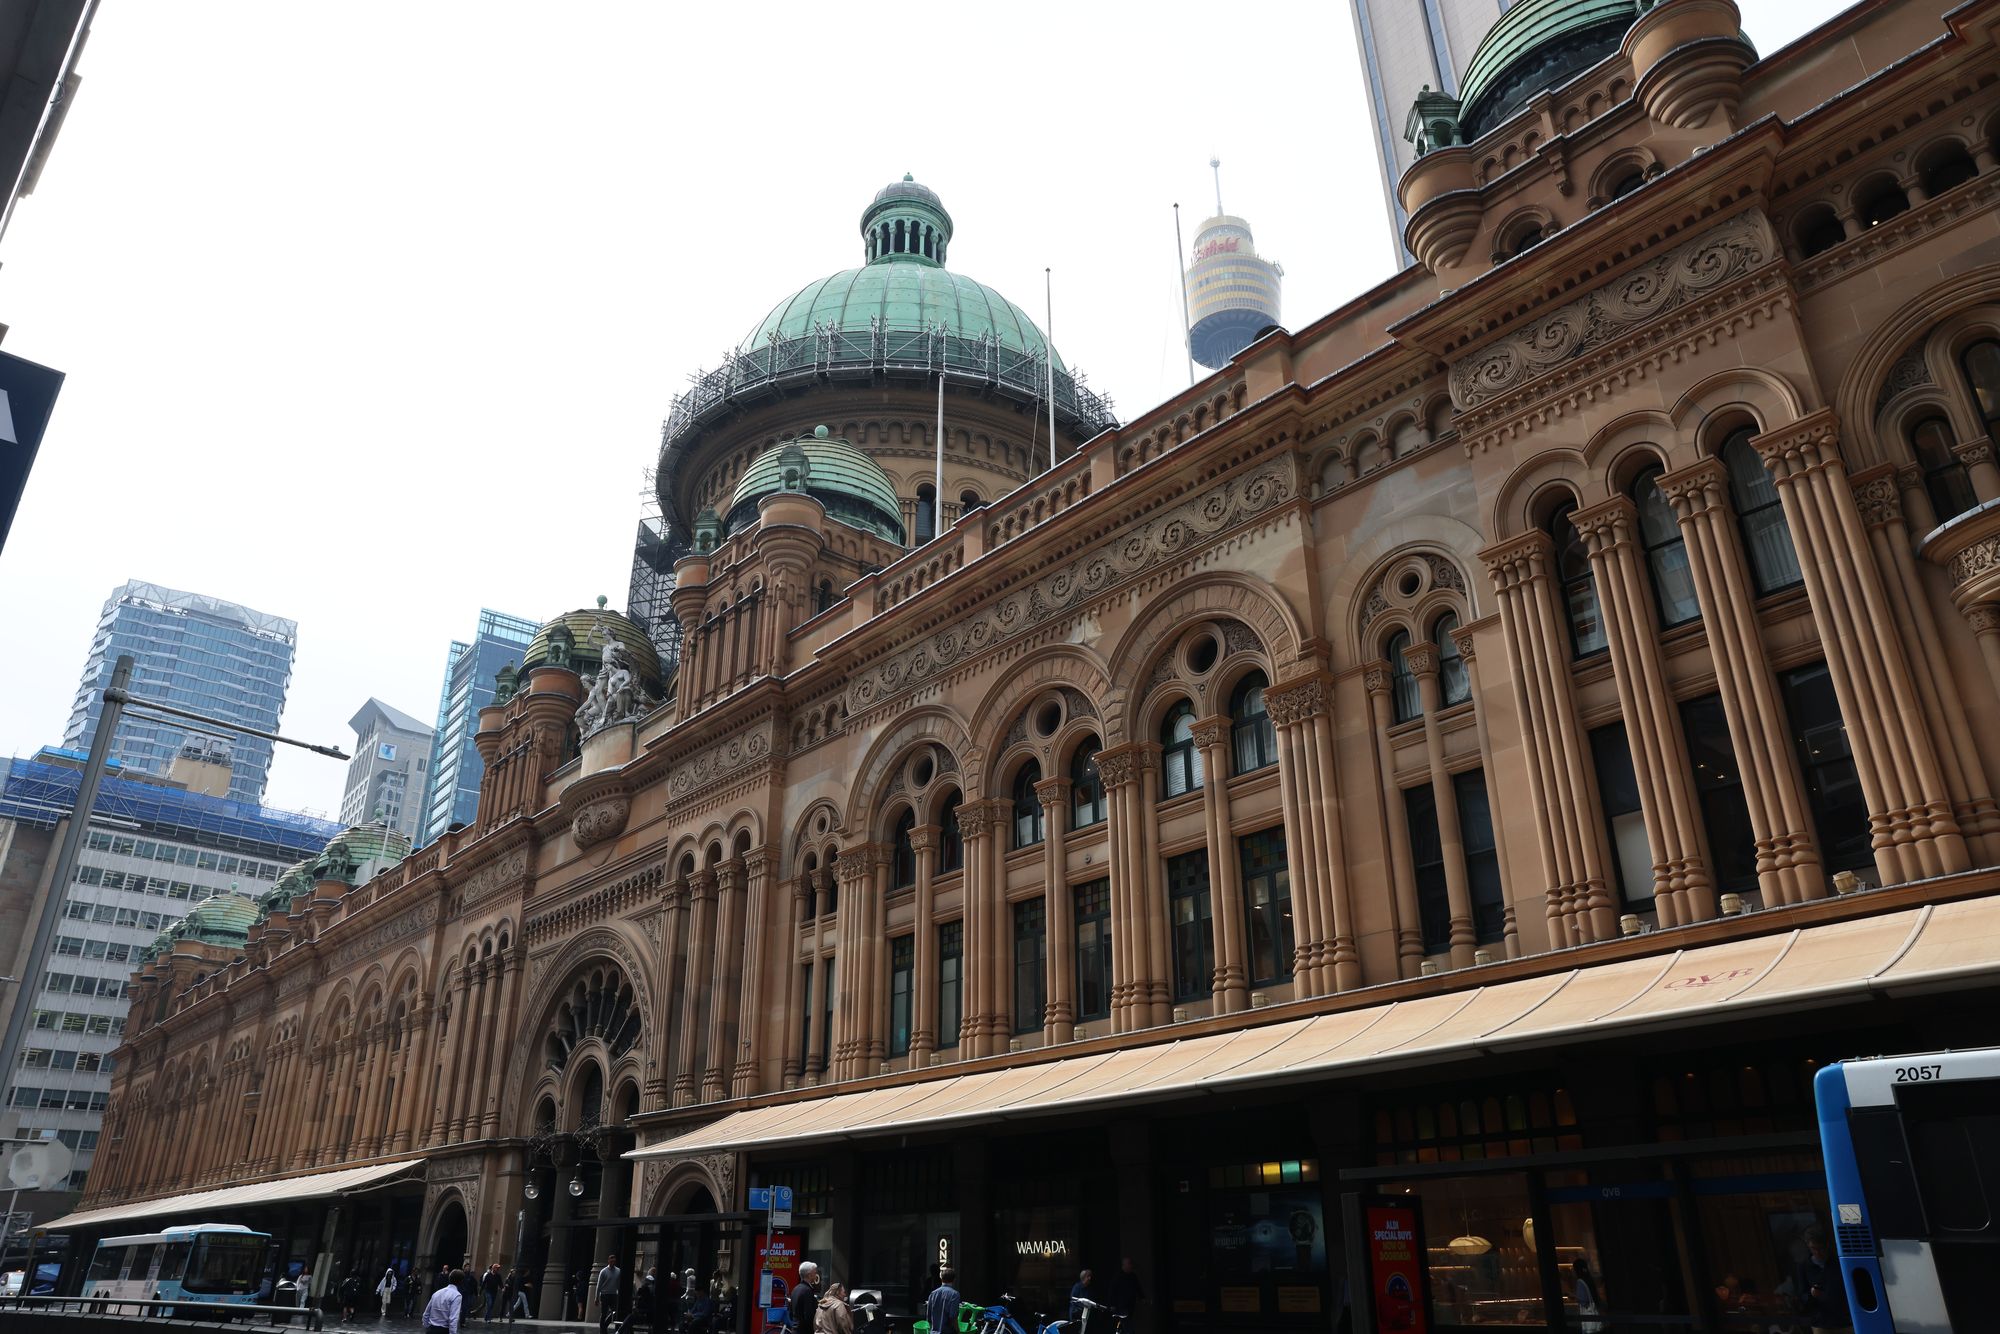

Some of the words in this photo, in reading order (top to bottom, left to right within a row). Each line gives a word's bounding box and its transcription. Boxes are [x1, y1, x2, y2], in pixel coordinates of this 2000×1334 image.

[1664, 967, 1754, 990] QVB
[1895, 1065, 1943, 1082] 2057
[1602, 1187, 1621, 1198] QVB
[1385, 1221, 1399, 1230] ALDI
[1374, 1231, 1397, 1241] SPECIAL
[1398, 1231, 1412, 1240] BUYS
[1016, 1240, 1066, 1255] WAMADA
